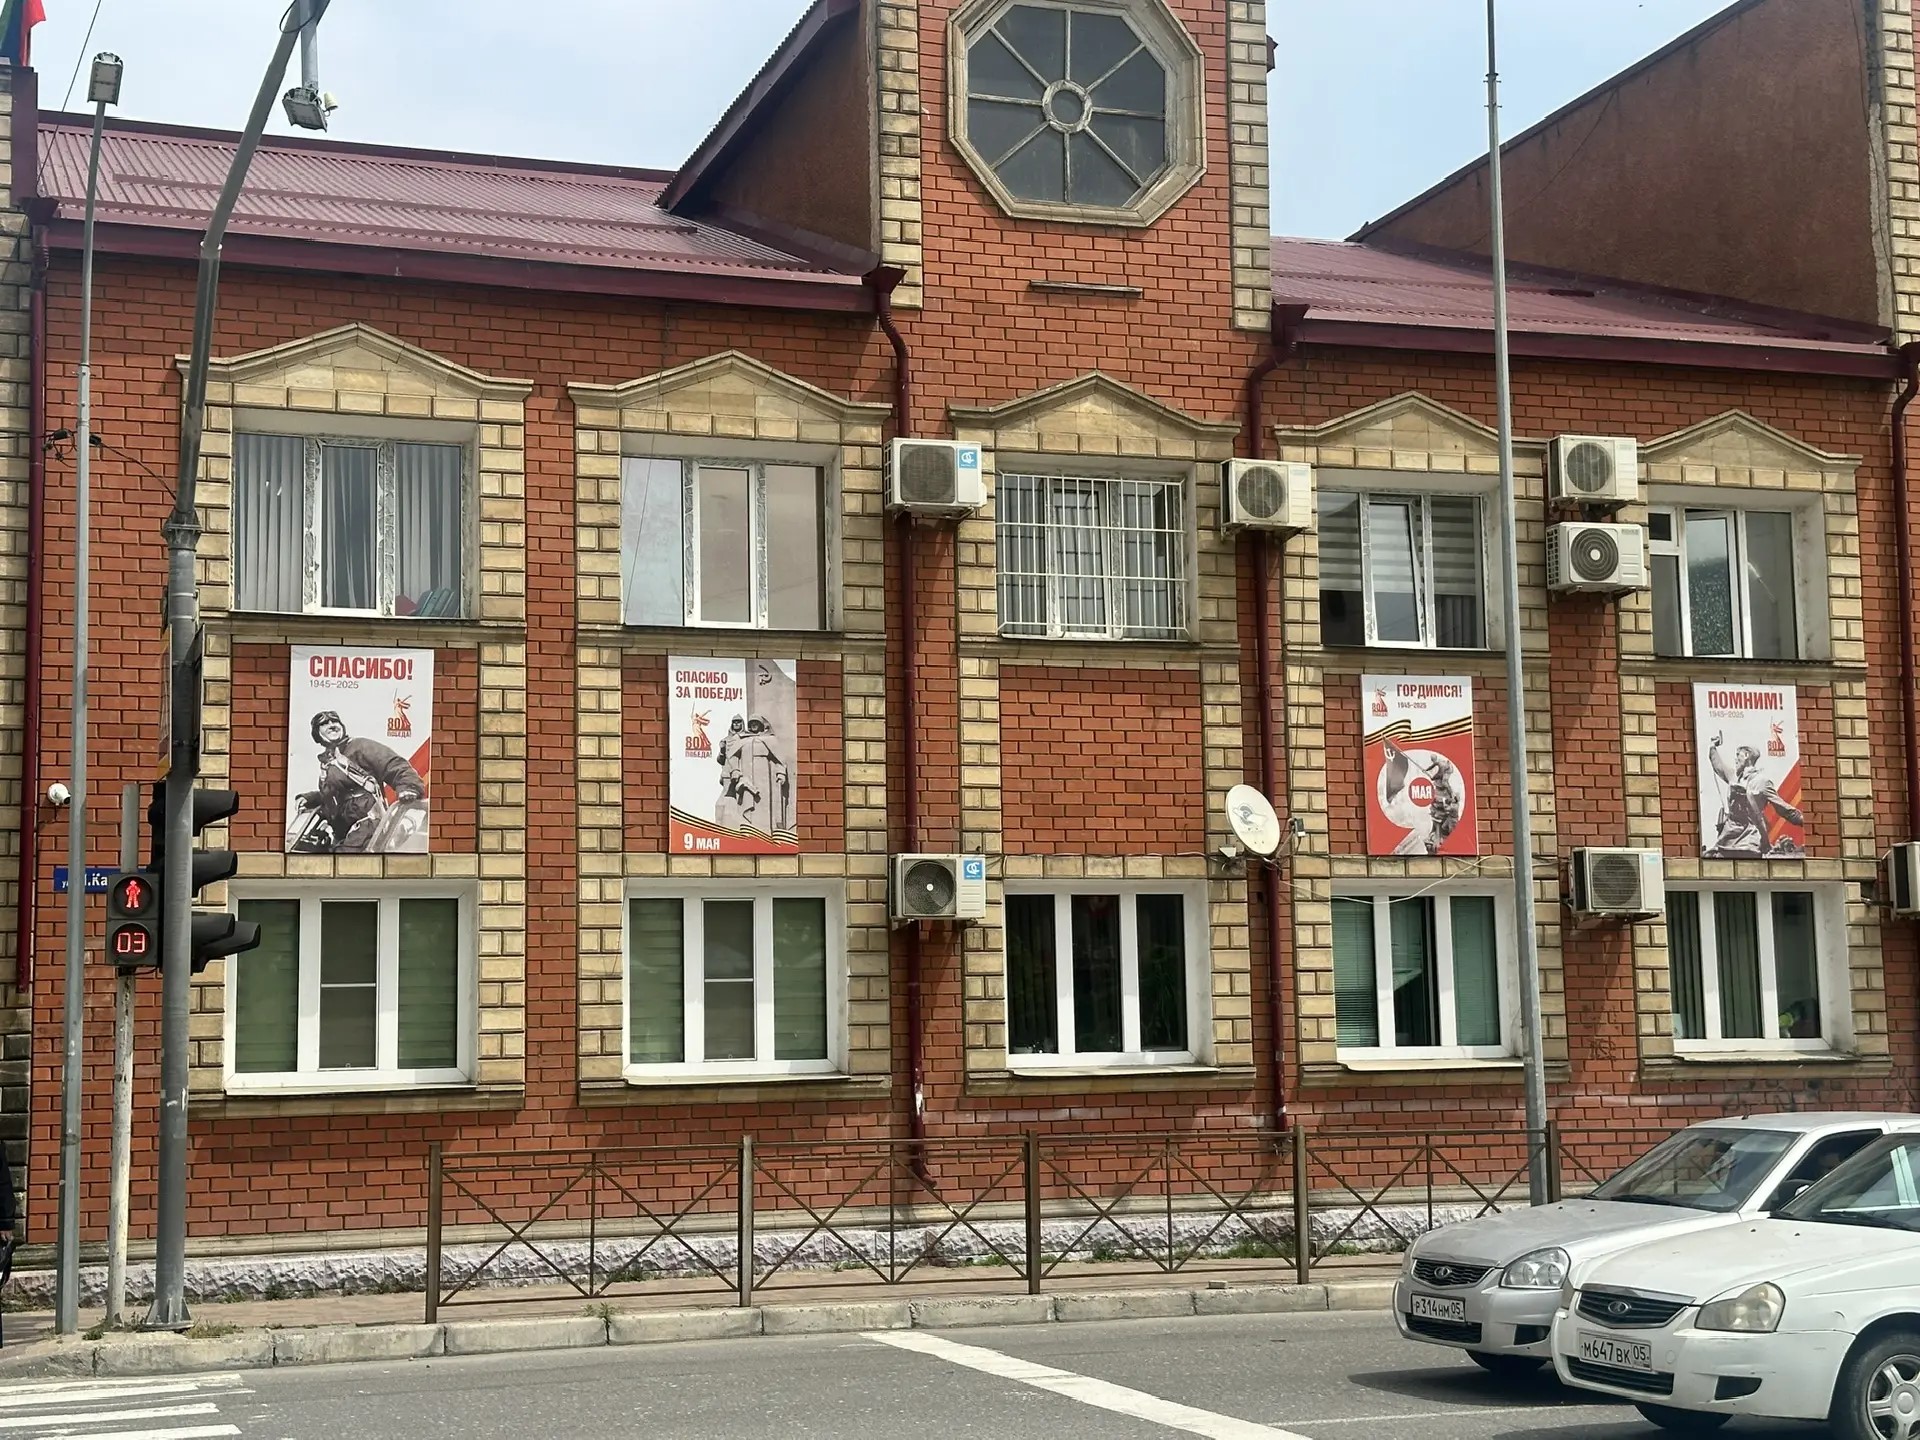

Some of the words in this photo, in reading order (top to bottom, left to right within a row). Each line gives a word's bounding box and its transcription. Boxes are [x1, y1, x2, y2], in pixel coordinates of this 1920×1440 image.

[309, 655, 413, 681] СПАСИБО!
[309, 680, 359, 689] 1945-2025
[675, 670, 728, 684] СПАСИБО
[675, 686, 691, 699] ЗА
[694, 686, 743, 701] ПОБЕДУ!
[1396, 684, 1463, 699] ГОРДИМСЯ!
[1708, 690, 1784, 710] ПОМНИМ!
[387, 717, 400, 730] 80
[685, 736, 700, 749] 80
[1411, 785, 1432, 799] МАЯ
[684, 833, 693, 850] 9
[696, 838, 720, 850] МАЯ
[116, 932, 146, 953] 03
